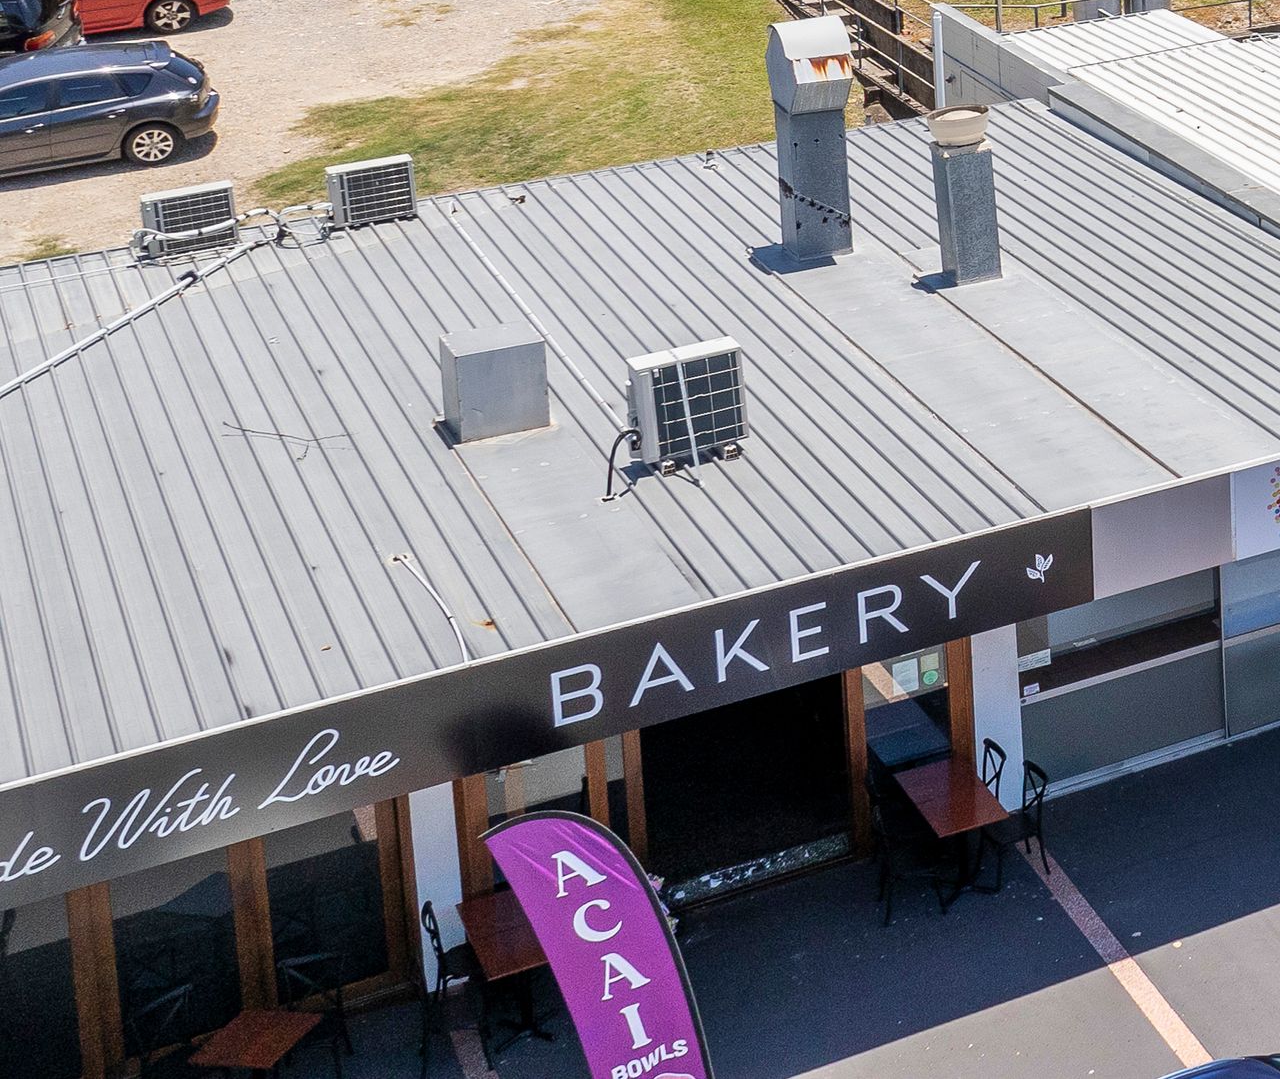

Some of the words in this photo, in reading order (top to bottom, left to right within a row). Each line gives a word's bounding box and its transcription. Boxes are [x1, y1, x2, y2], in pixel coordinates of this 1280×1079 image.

[549, 559, 982, 729] BAKERY
[79, 768, 241, 863] With
[256, 728, 400, 811] Love
[550, 849, 653, 1051] ACAI
[610, 1038, 689, 1079] BOWLS
